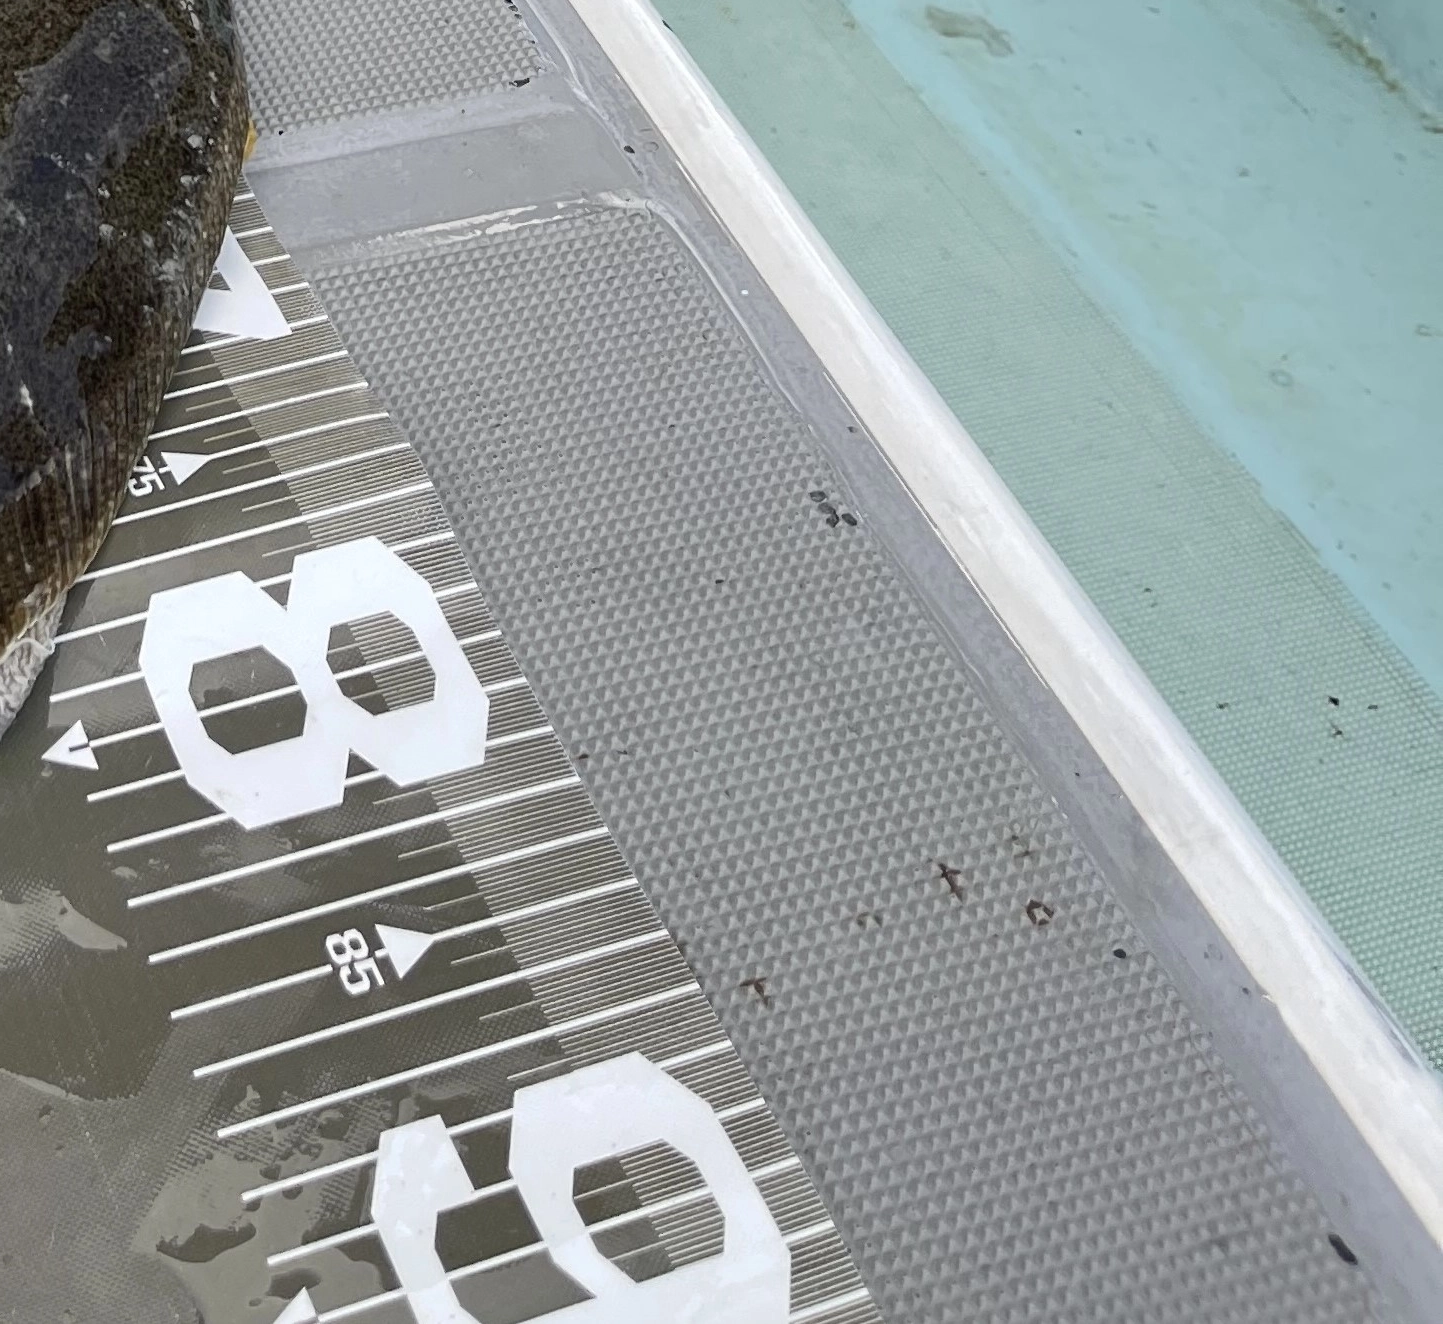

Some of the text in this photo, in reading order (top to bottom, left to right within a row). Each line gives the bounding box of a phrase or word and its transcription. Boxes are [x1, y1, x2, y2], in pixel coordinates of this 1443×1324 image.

[139, 535, 491, 830] 8
[325, 928, 386, 996] 85
[371, 1051, 792, 1324] 9
